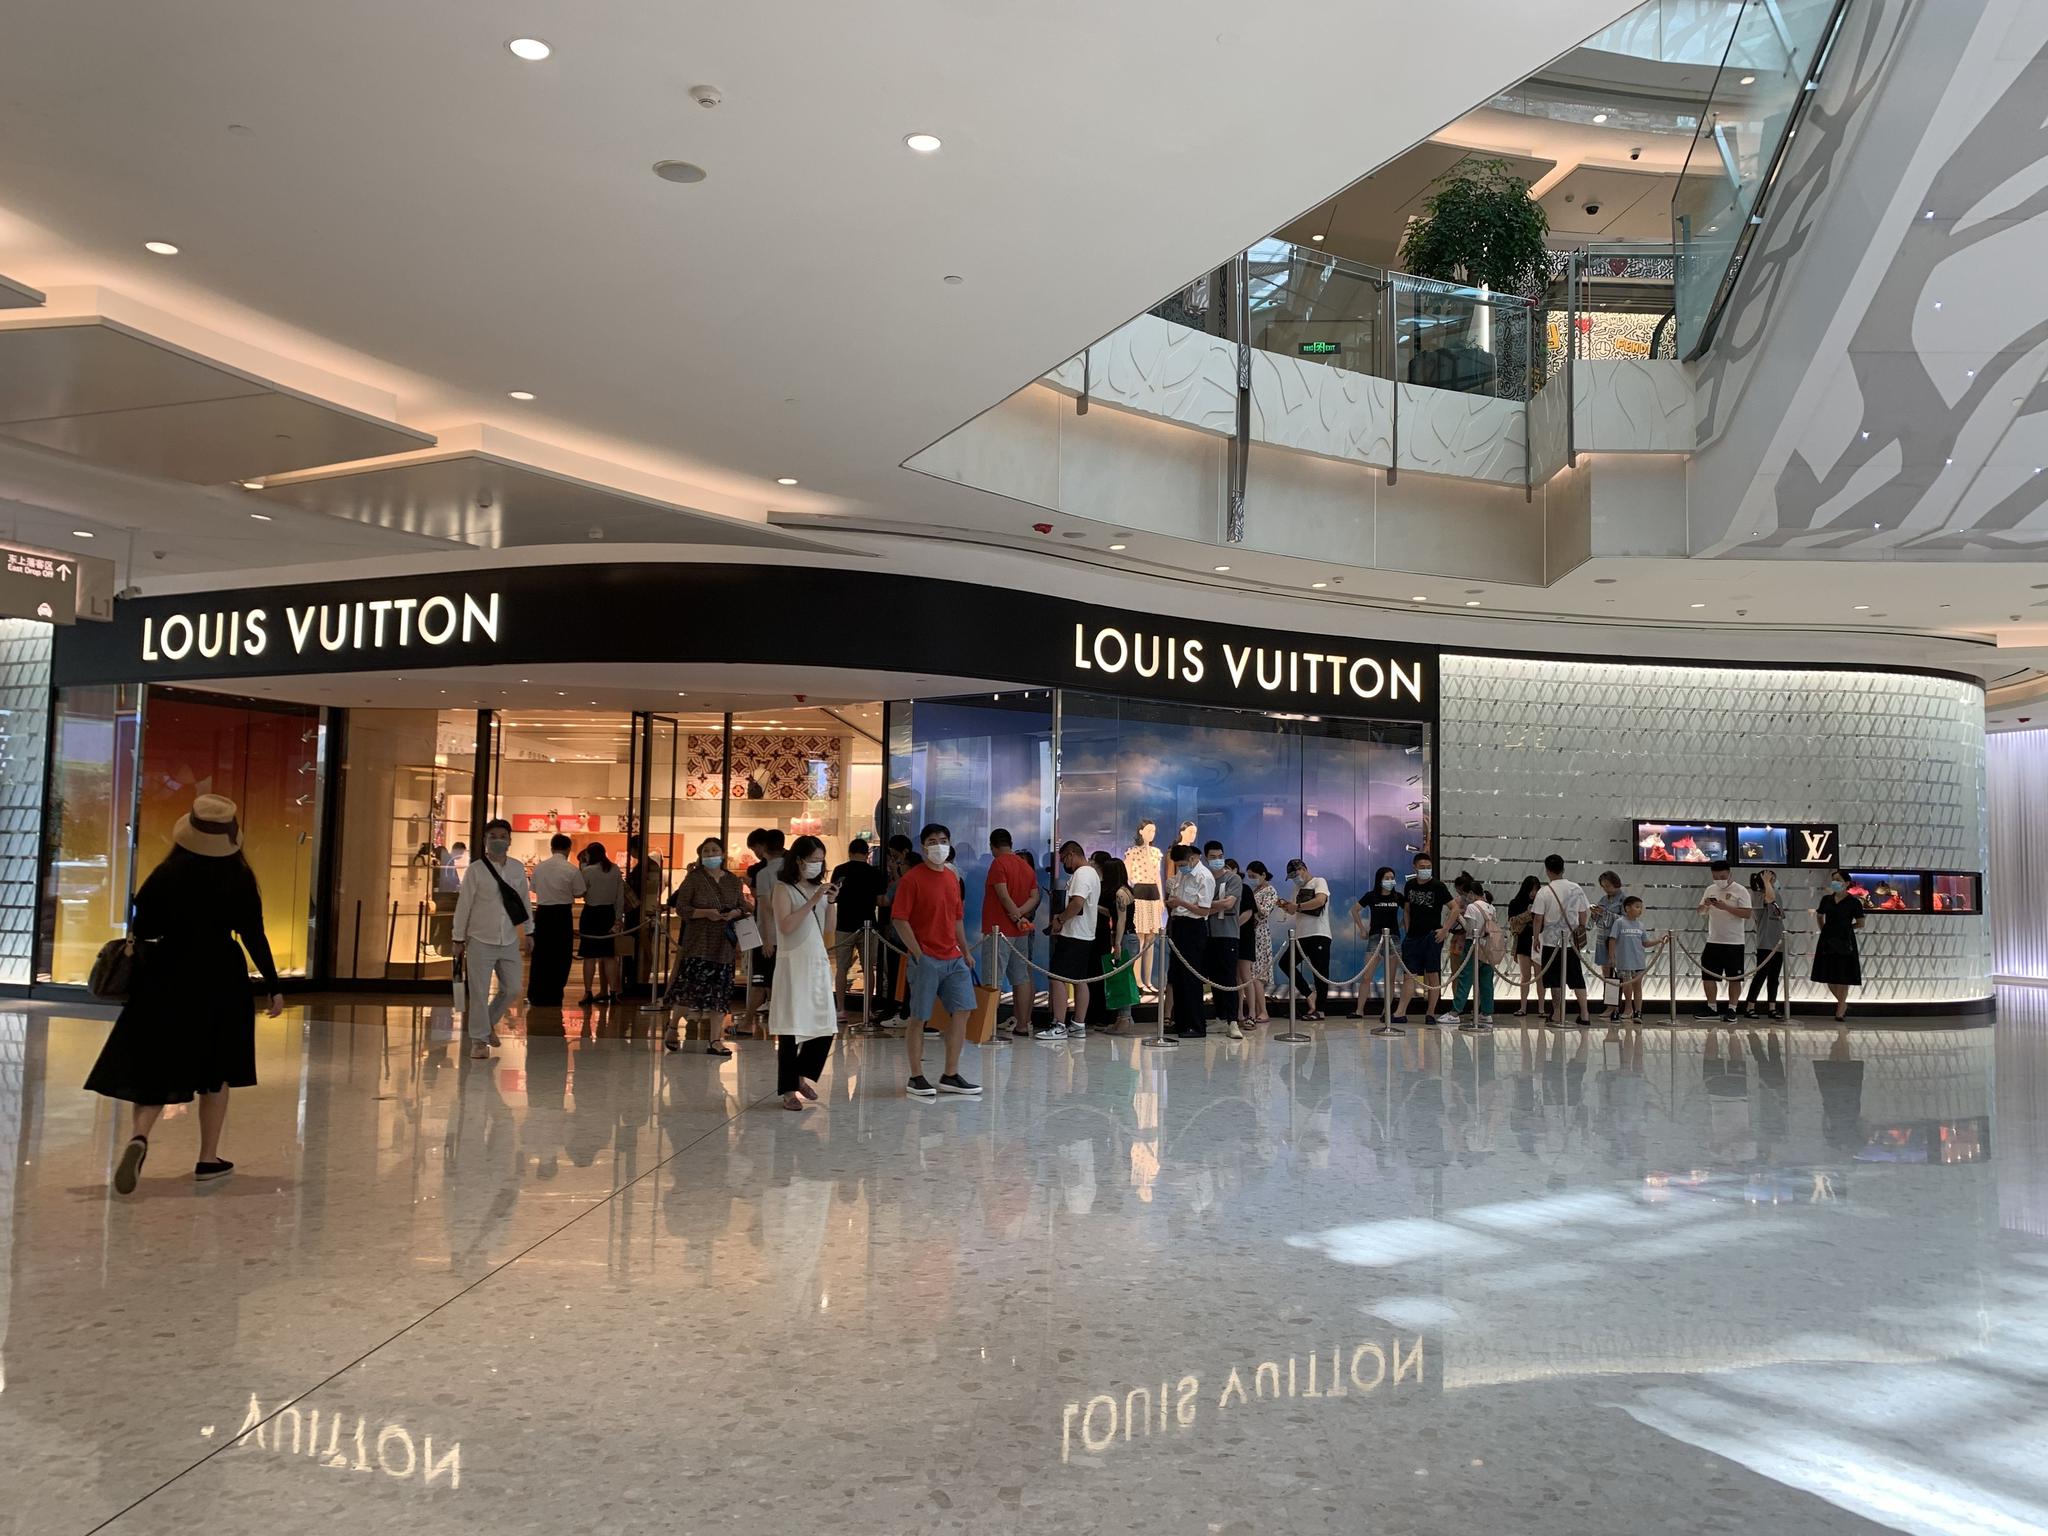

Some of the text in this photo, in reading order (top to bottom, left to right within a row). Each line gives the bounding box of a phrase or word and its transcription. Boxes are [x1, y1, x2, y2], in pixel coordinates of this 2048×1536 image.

[1616, 338, 1651, 355] FENDI
[8, 563, 54, 578] East Drop Off
[91, 595, 110, 618] L1
[142, 592, 499, 661] LOUIS VUITTON
[1074, 623, 1421, 703] LOUIS VUITTON
[1800, 830, 1833, 863] LV
